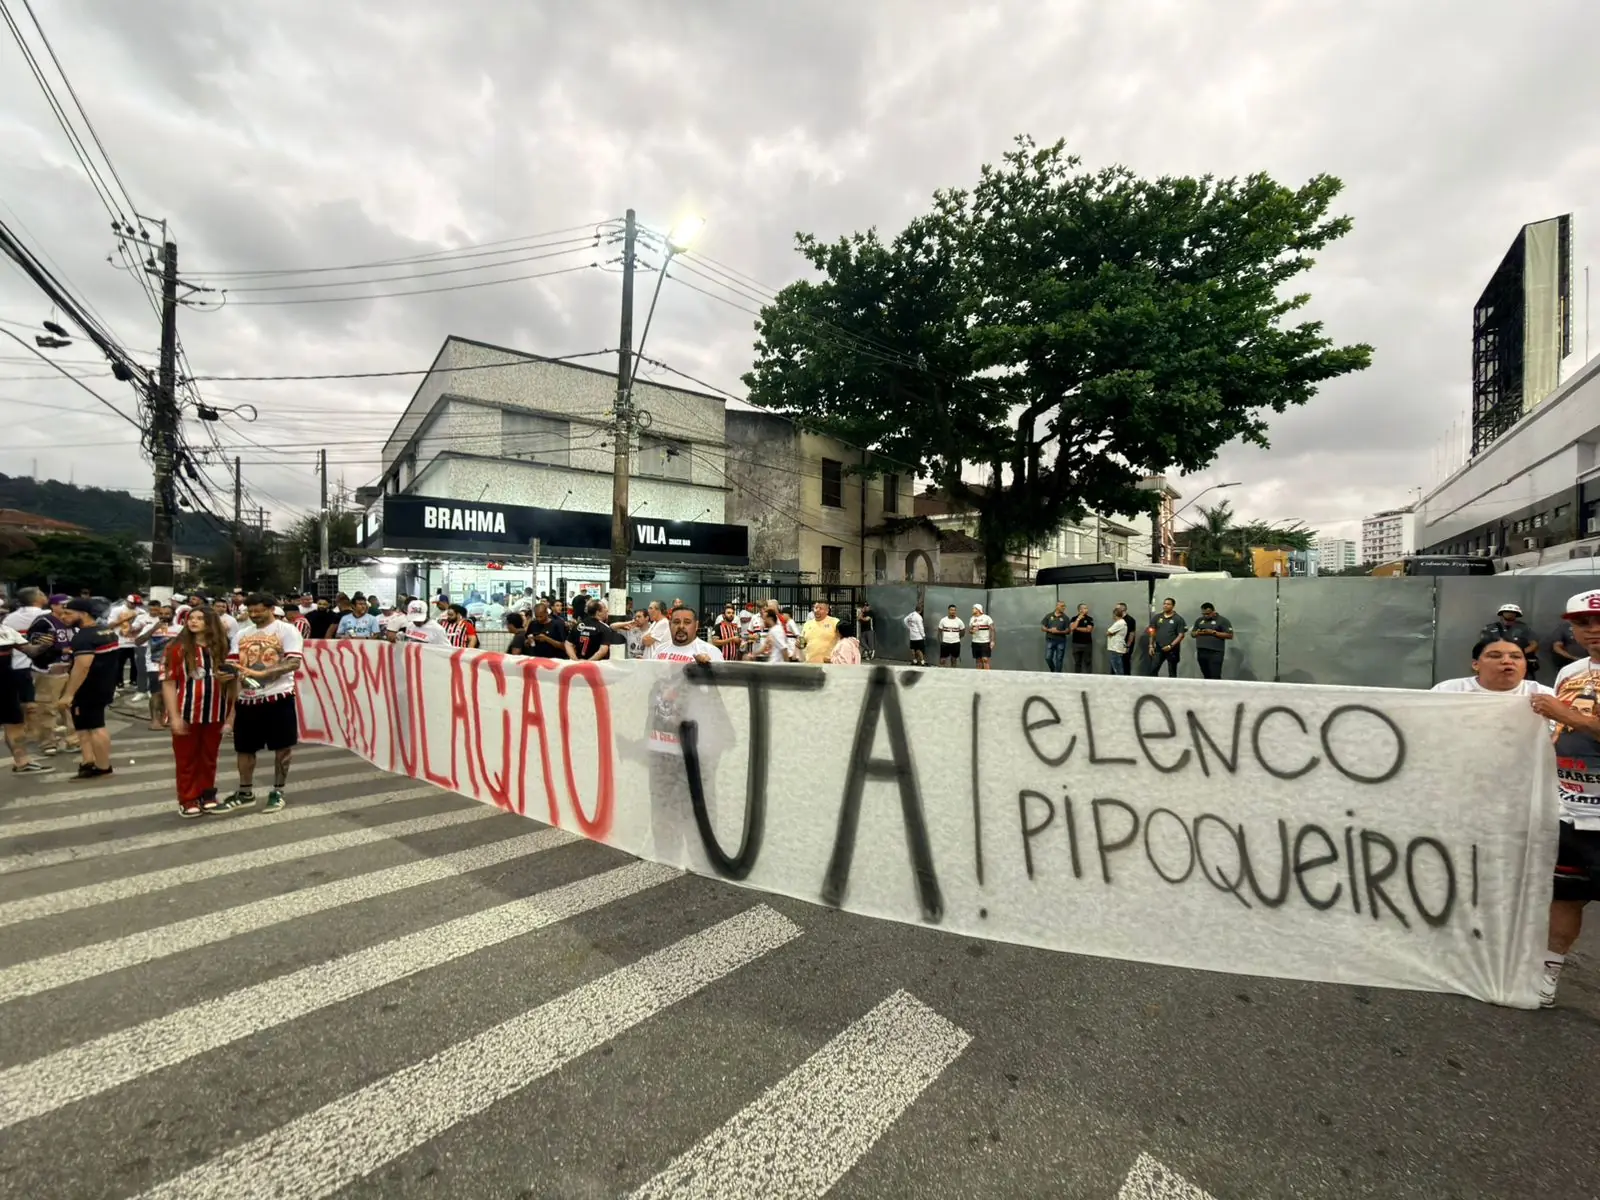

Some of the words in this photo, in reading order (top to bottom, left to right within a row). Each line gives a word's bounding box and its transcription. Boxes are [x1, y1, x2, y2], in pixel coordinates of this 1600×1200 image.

[424, 506, 506, 533] BRAHMA
[637, 524, 667, 545] VILA
[579, 635, 590, 656] 7
[294, 639, 615, 840] EFORMULAÇÃO
